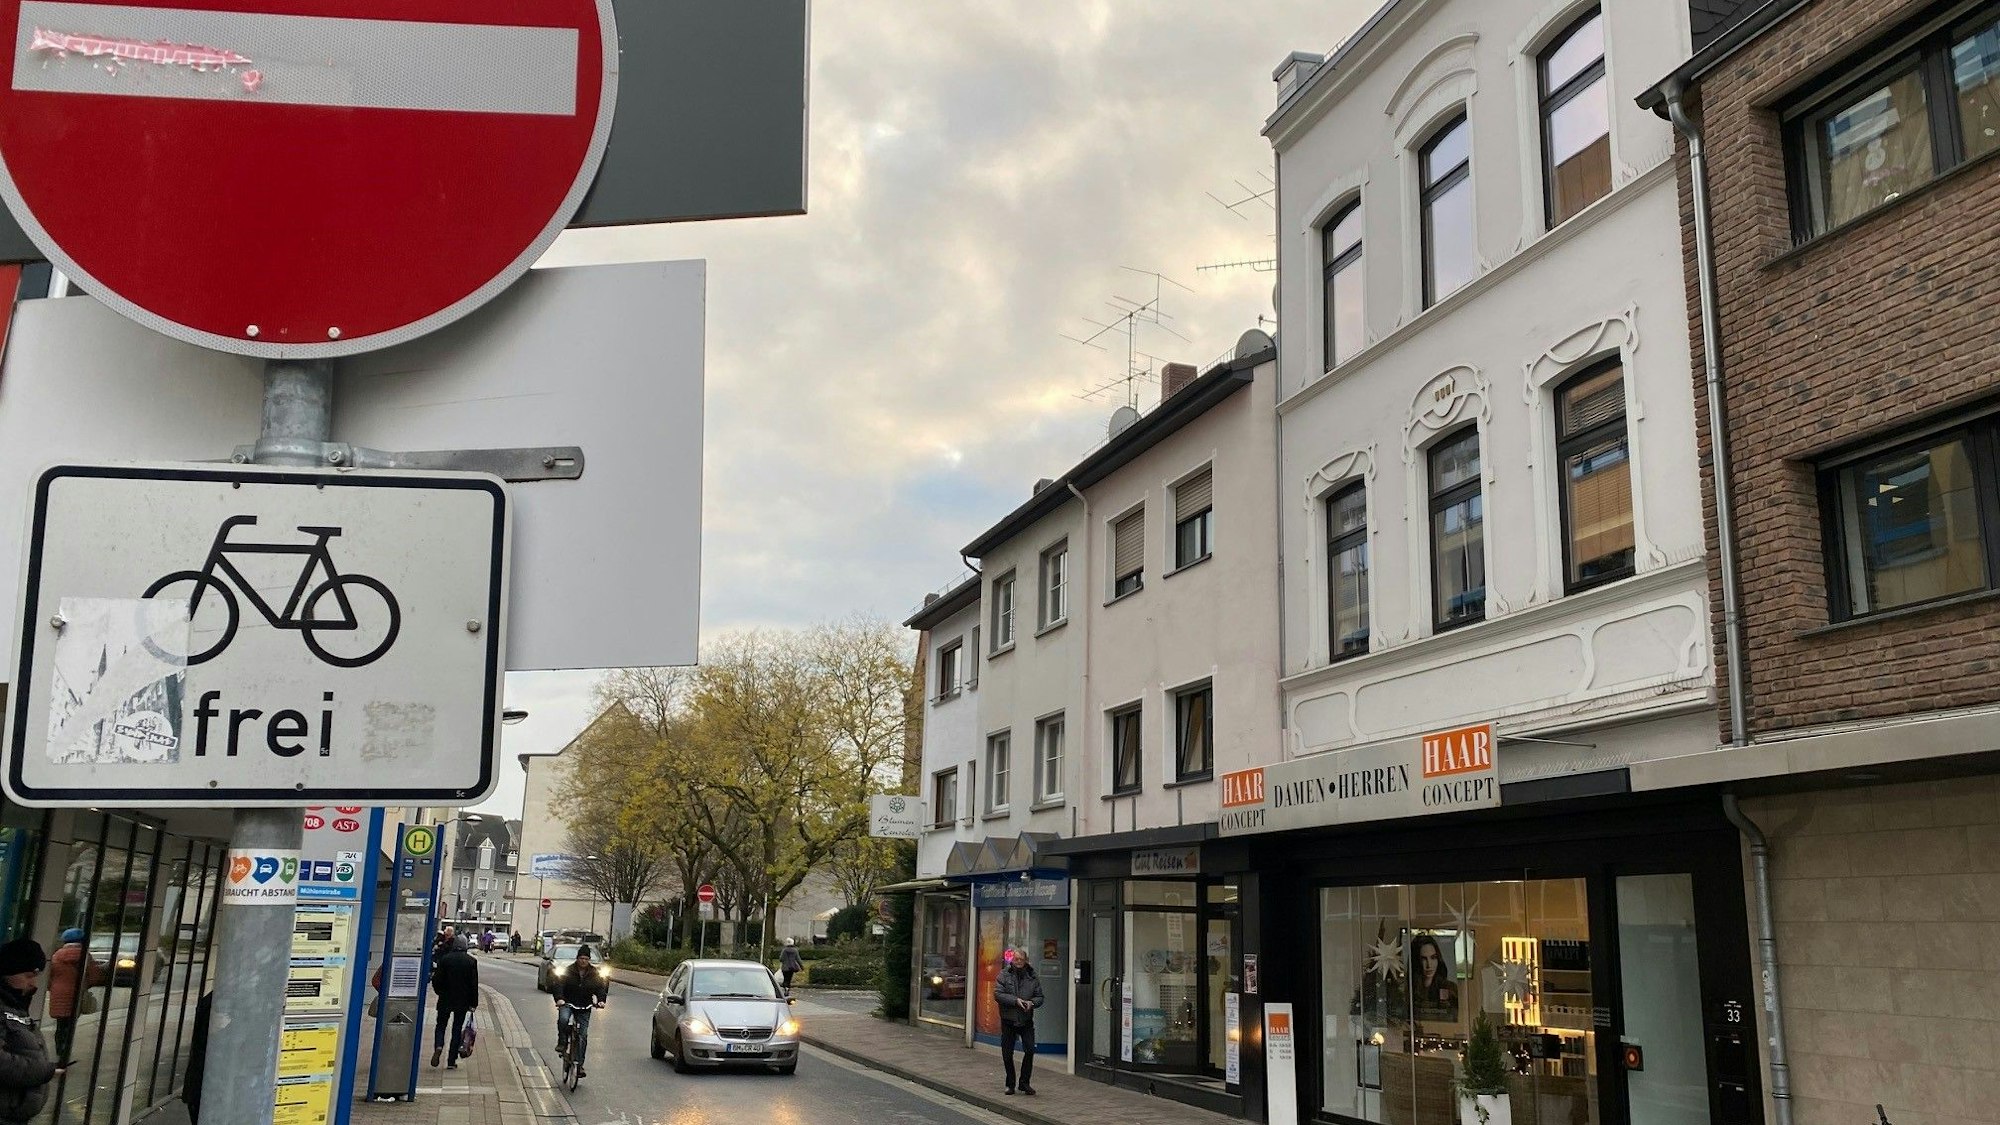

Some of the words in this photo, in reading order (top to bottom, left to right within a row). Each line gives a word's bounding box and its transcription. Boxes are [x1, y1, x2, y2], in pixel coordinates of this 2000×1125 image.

[193, 690, 334, 757] frei
[1423, 731, 1490, 774] HAAR
[1222, 772, 1263, 804] HAAR
[1423, 777, 1494, 807] CONCEPT
[335, 820, 357, 831] AST
[1221, 809, 1266, 831] CONCEPT
[414, 834, 426, 849] H
[1727, 1009, 1740, 1022] 33
